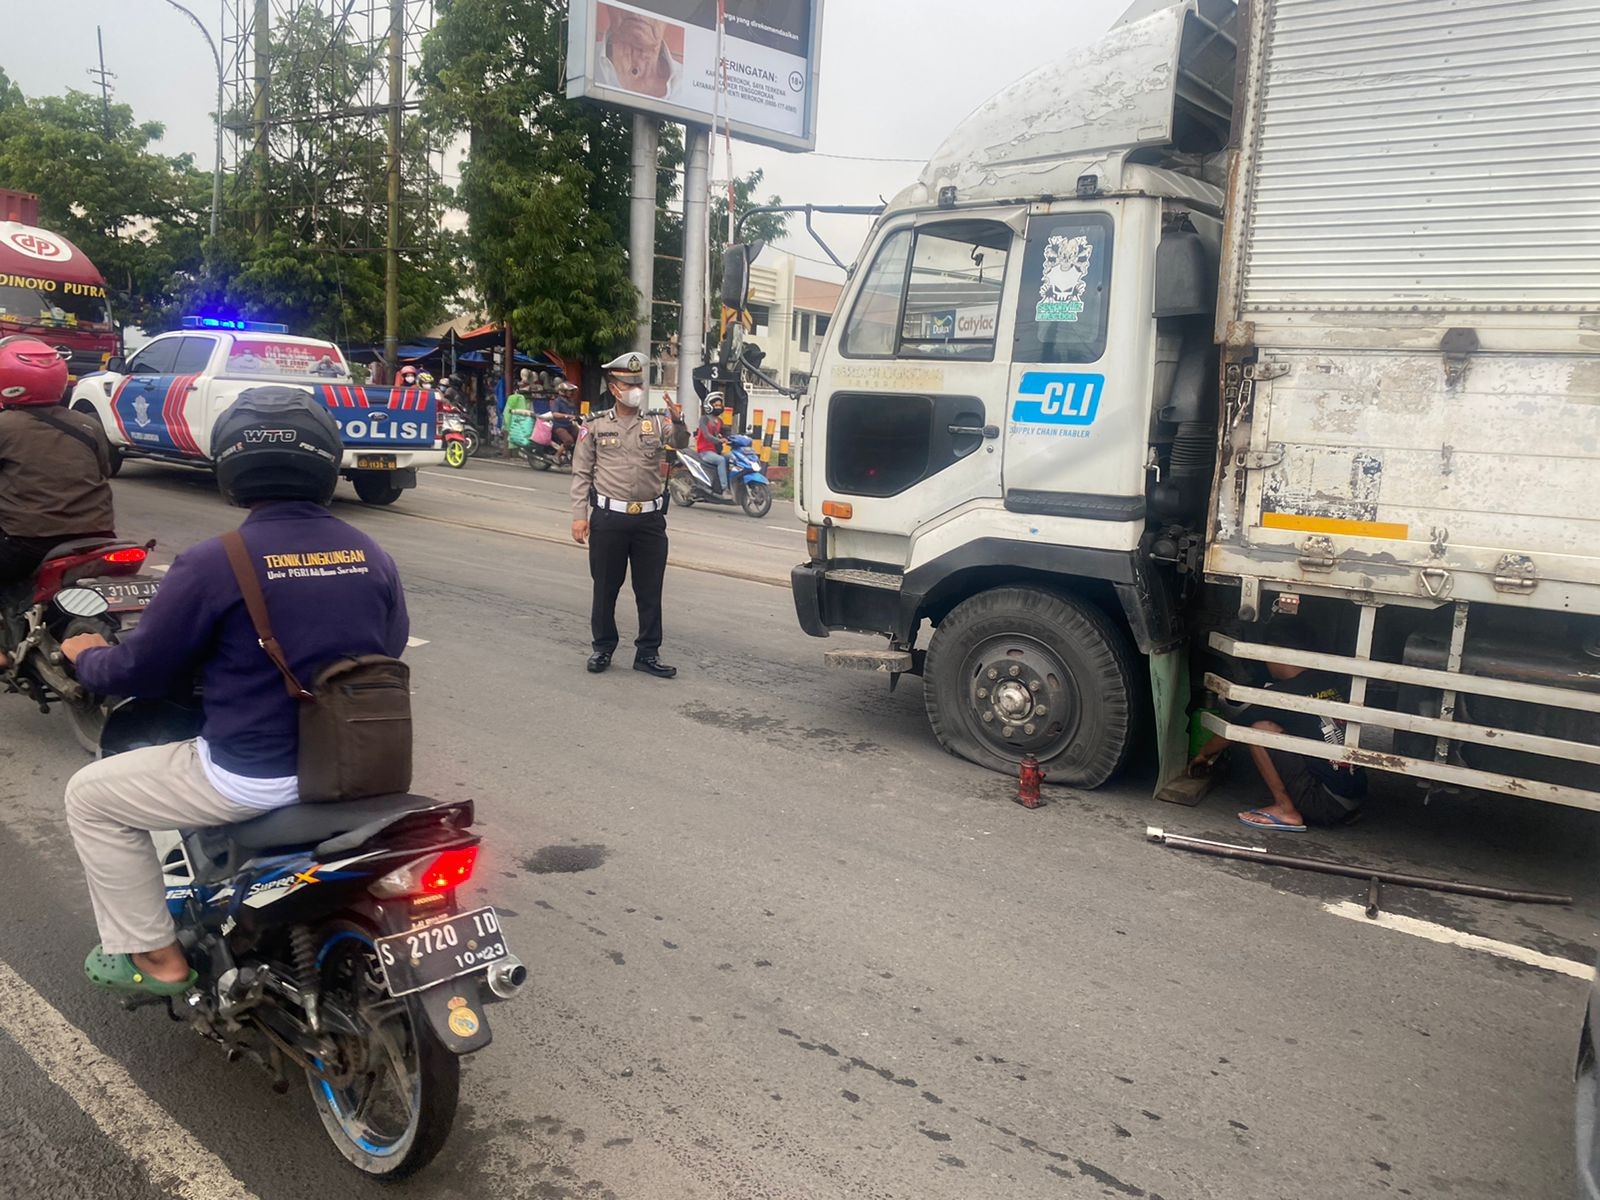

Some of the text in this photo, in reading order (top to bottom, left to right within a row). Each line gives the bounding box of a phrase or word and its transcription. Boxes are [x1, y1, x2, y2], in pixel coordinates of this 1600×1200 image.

[64, 282, 106, 299] PUTRA
[957, 316, 994, 336] Catylac
[711, 366, 719, 379] 3
[1040, 382, 1095, 417] CLI
[1036, 427, 1058, 437] CHAIN
[1058, 428, 1091, 438] ENABLER
[263, 549, 366, 569] TEKNIK LINGKUNGAN
[287, 568, 310, 578] PGRI
[108, 584, 140, 597] 3710
[143, 583, 160, 595] JA
[413, 893, 445, 906] HONDA
[380, 942, 396, 967] S
[406, 924, 459, 960] 2720
